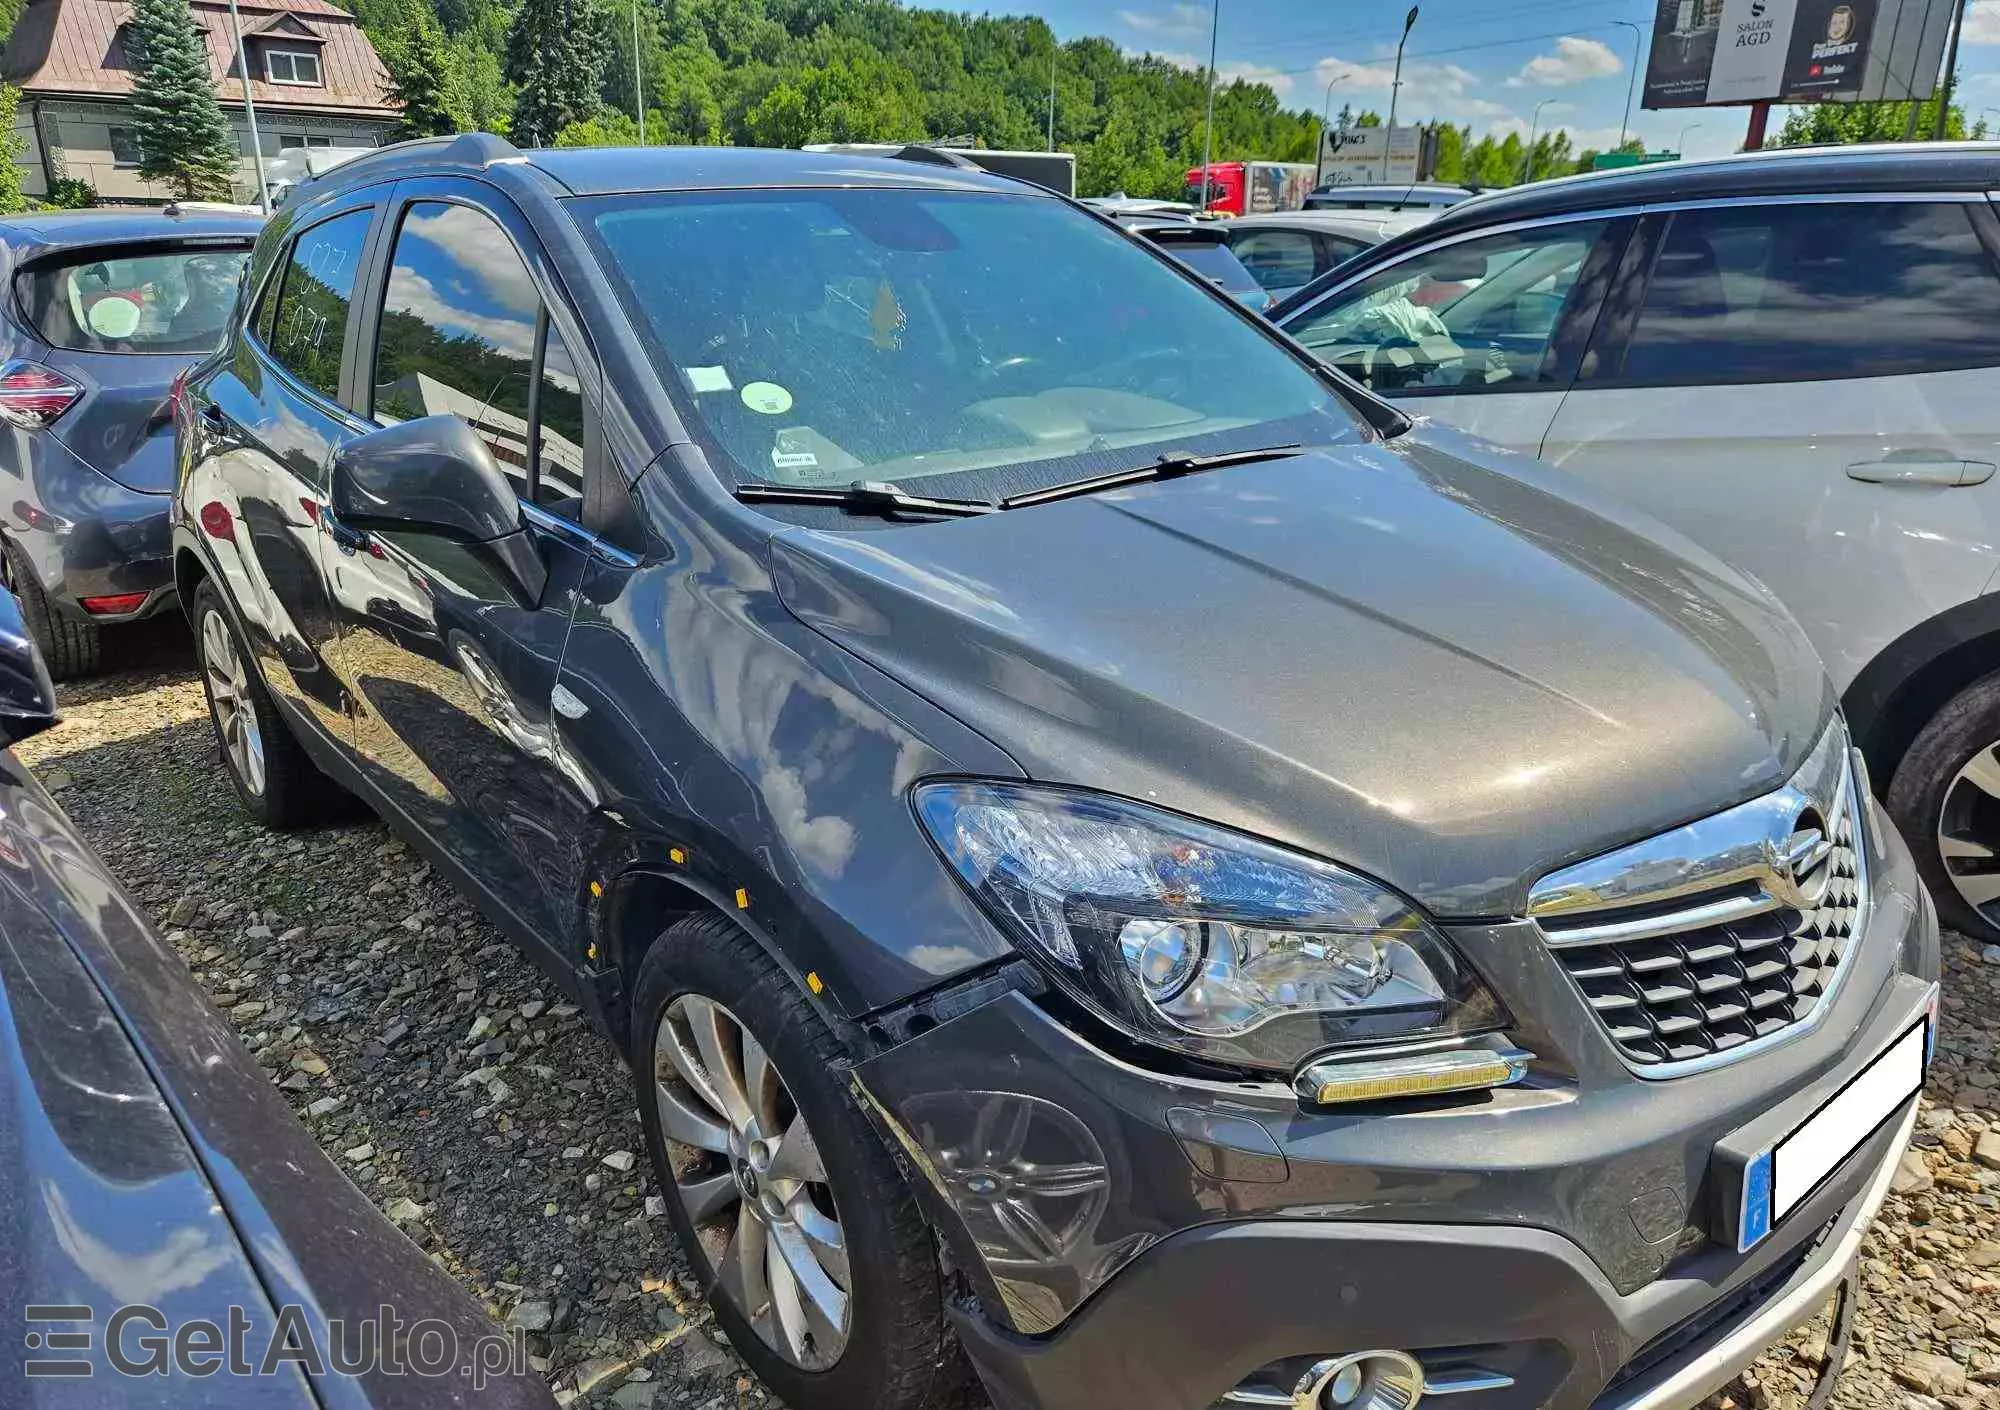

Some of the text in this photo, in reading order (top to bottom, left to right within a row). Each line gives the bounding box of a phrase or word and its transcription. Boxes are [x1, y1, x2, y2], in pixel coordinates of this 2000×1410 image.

[1736, 18, 1774, 33] SALON
[1735, 30, 1771, 48] AGD
[1752, 1207, 1762, 1231] F
